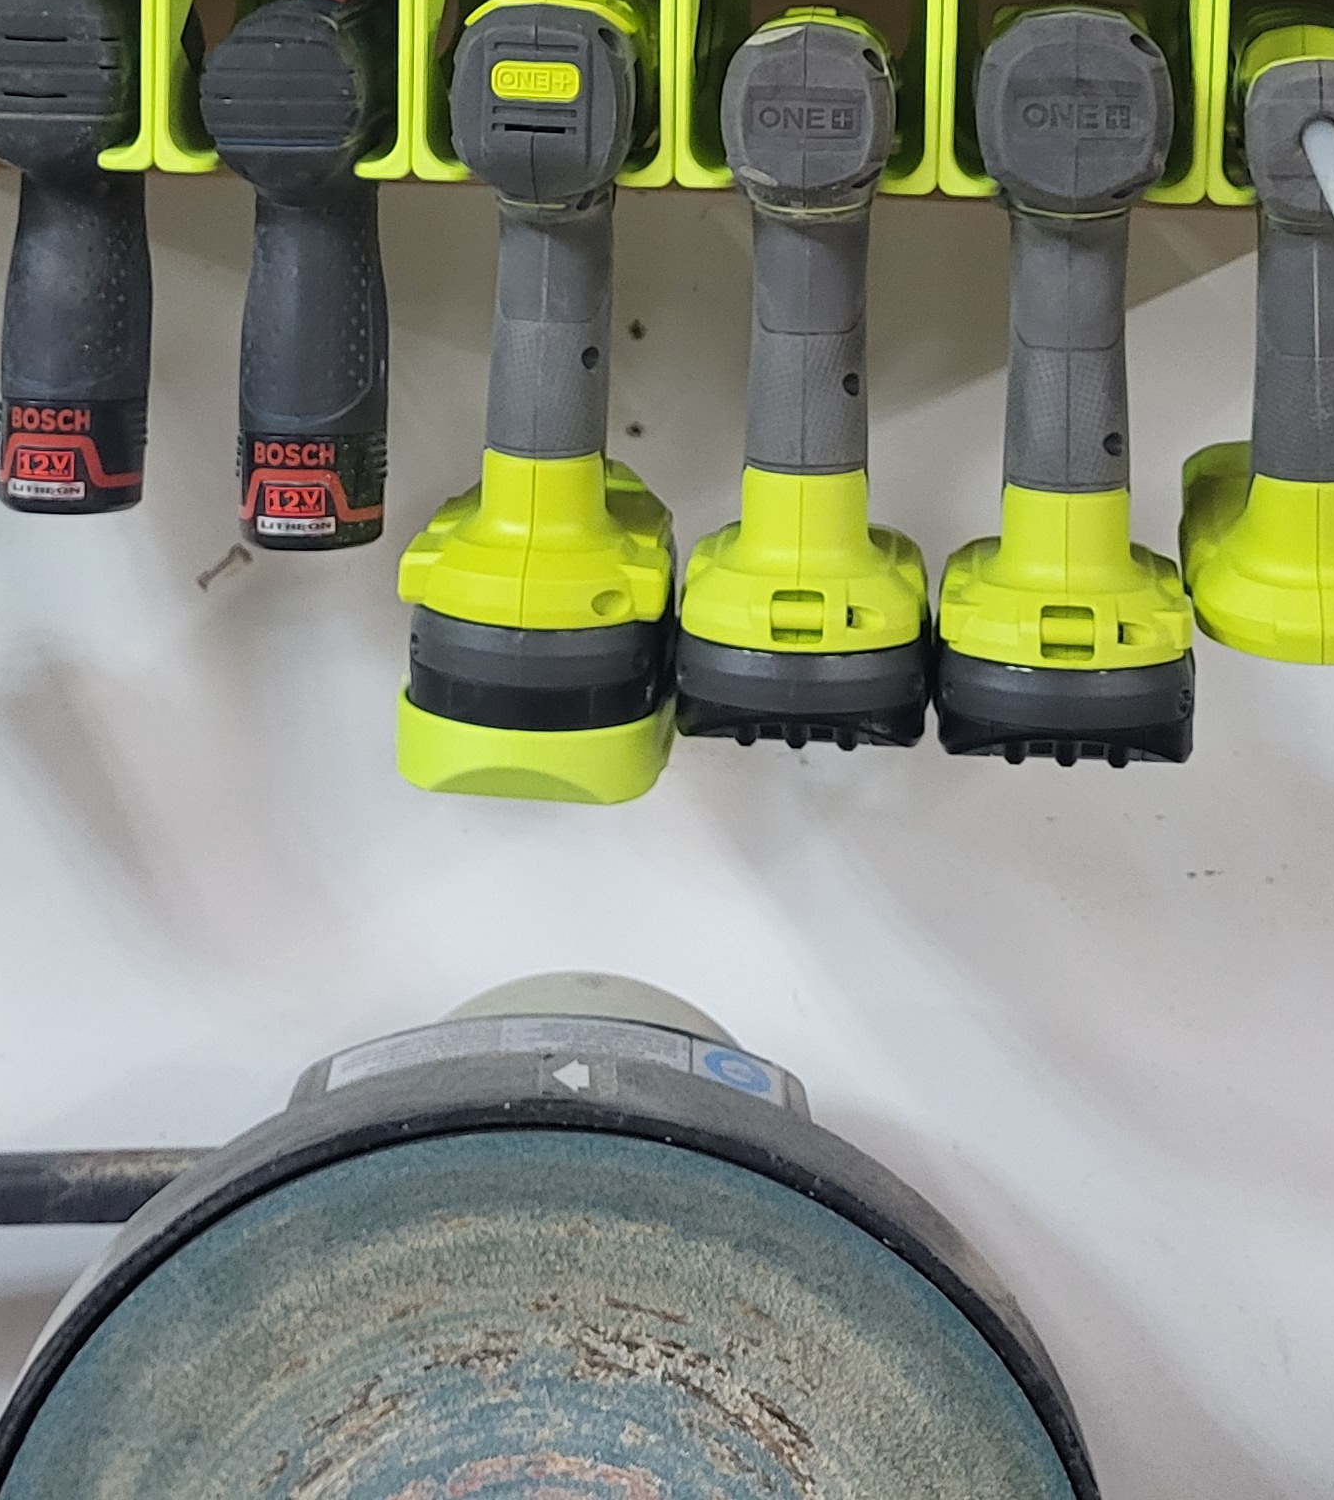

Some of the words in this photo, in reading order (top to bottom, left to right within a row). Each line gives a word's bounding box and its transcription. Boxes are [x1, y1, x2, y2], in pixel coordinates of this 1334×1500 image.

[11, 406, 91, 432] BOSCH
[20, 453, 70, 476] 12V
[254, 441, 336, 467] BOSCH
[268, 489, 321, 513] 12V
